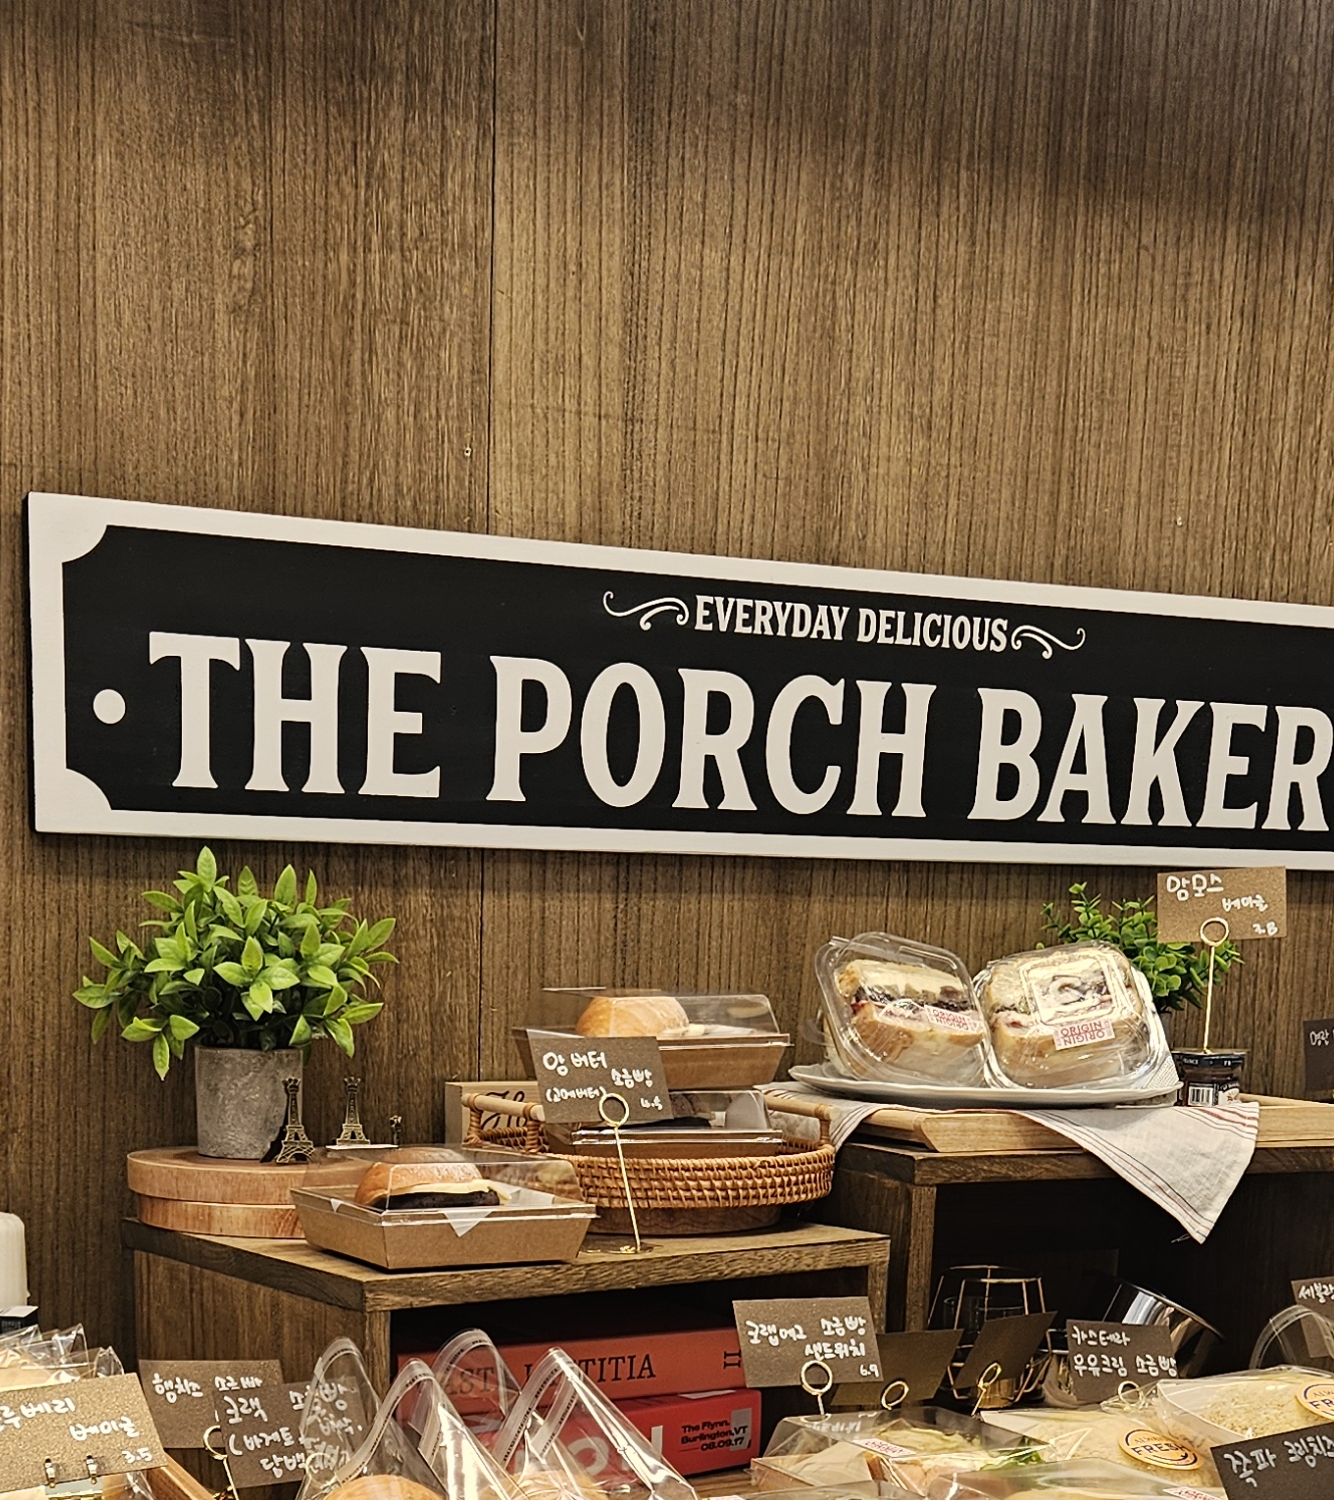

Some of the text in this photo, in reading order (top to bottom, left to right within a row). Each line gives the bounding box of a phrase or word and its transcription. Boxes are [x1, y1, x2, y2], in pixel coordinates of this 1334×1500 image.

[694, 594, 1008, 653] EVERYDAY DELICIOUS
[149, 631, 442, 798] THE
[485, 655, 938, 819] PORCH
[1221, 893, 1269, 912] 베이글
[1060, 1020, 1104, 1038] ORIGIN
[610, 1067, 654, 1090] 소금빵
[820, 1315, 867, 1337] 소금빵
[1070, 1324, 1131, 1347] 카스테라
[803, 1338, 866, 1361] 샌드위치
[859, 1363, 880, 1378] 6.9
[1072, 1352, 1179, 1378] 우유크림 소금빵
[151, 1372, 204, 1404] 햄치즈
[69, 1415, 141, 1442] 베이글
[680, 1424, 700, 1434] The
[120, 1447, 154, 1464] 3.5
